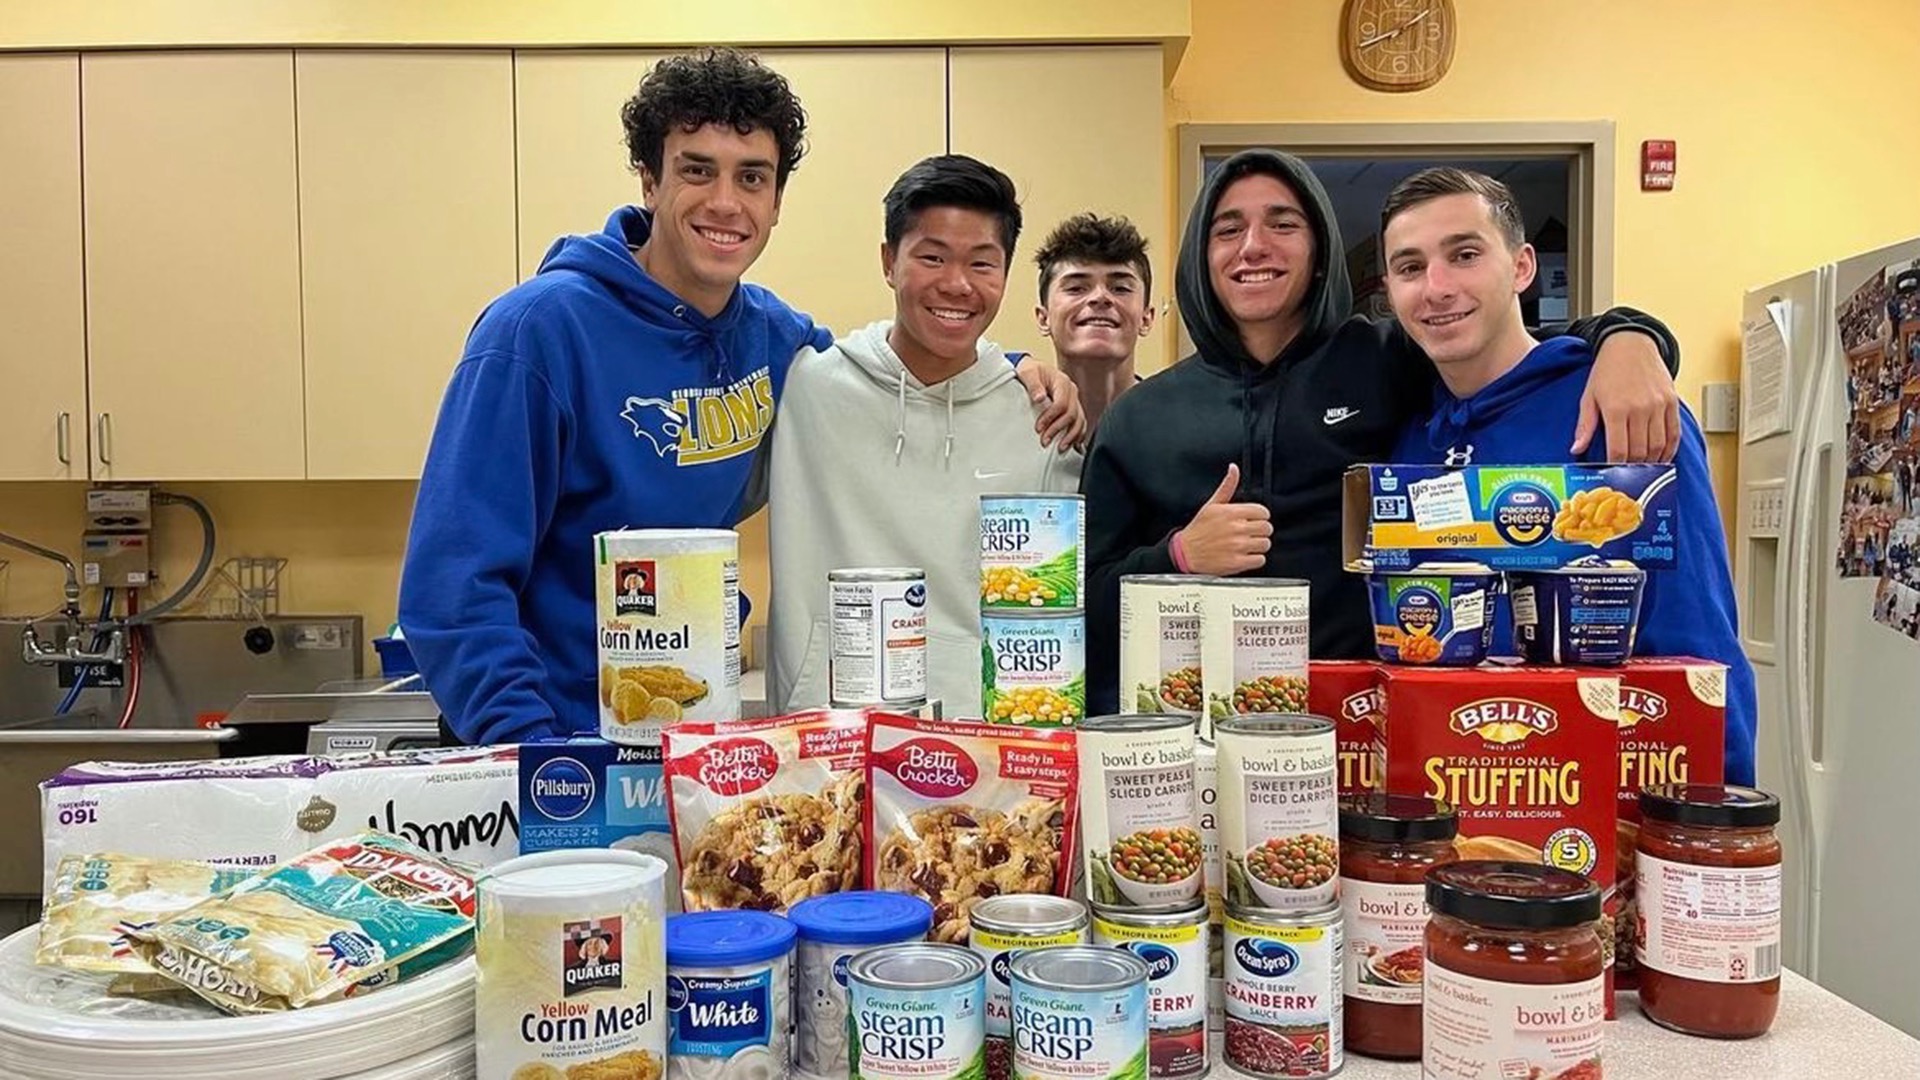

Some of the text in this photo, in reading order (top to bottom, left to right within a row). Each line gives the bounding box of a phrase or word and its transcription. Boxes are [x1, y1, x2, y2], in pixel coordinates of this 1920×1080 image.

[1360, 22, 1377, 40] 9
[1427, 22, 1441, 41] 3
[1392, 55, 1408, 73] 6
[1651, 161, 1673, 171] FIRE
[672, 376, 774, 451] LIONS
[1326, 406, 1349, 418] NIKE
[1657, 520, 1667, 533] 4
[1436, 532, 1478, 546] original
[1652, 533, 1673, 543] pack
[616, 595, 655, 608] QUAKER
[1158, 600, 1190, 614] bowl
[1232, 603, 1282, 619] bowl &
[600, 624, 689, 650] Corn Meal
[1001, 627, 1029, 636] Green
[1163, 631, 1199, 640] SLICED
[1243, 625, 1303, 636] SWEET PEAS
[996, 637, 1061, 654] steam
[1237, 637, 1276, 647] SLICED
[997, 654, 1061, 671] CRISP
[1457, 702, 1552, 730] BELL'S
[915, 722, 932, 731] New
[955, 727, 975, 735] same
[976, 728, 998, 737] great
[617, 747, 661, 762] Moist
[905, 744, 959, 771] Betty
[1006, 750, 1054, 765] Ready in
[1101, 752, 1138, 767] bowl
[1141, 753, 1155, 767] &
[1448, 756, 1560, 767] TRADITIONAL
[1006, 764, 1067, 779] 3 easy steps
[1241, 755, 1279, 773] bowl
[1283, 760, 1297, 772] &
[1620, 745, 1688, 787] FING
[699, 763, 774, 785] Crocker
[896, 761, 971, 788] Crocker
[1113, 771, 1184, 786] SWEET PEAS
[1424, 757, 1581, 806] STUFFING
[535, 778, 592, 800] Pillsbury
[1251, 778, 1326, 791] SWEET PEAS
[1110, 787, 1151, 799] SLICED
[1250, 793, 1287, 804] DICED
[57, 801, 98, 809] napkins
[59, 809, 98, 825] 160
[1473, 810, 1565, 819] EASY. DELICIOUS.
[525, 826, 599, 839] MAKES 24
[525, 838, 599, 848] CUPCAKES
[1560, 842, 1580, 860] 5
[344, 849, 476, 903] IDAHOAN
[1662, 866, 1698, 878] Nutrition
[1662, 873, 1683, 882] Facts
[1359, 897, 1418, 916] bowl &
[1685, 909, 1698, 919] 40
[1122, 930, 1146, 939] RECIPE
[1269, 929, 1279, 937] ON
[1002, 939, 1026, 947] RECIPE
[1150, 956, 1171, 974] pray
[1236, 946, 1291, 973] Ocean Spray
[566, 962, 620, 985] QUAKER
[994, 959, 1012, 978] Oce
[687, 977, 761, 991] Creamy Supreme
[1236, 978, 1296, 993] WHOLE BERRY
[866, 996, 899, 1011] Green
[1018, 991, 1048, 1008] Green
[1226, 982, 1317, 1010] CRANBERRY
[521, 989, 653, 1043] Corn Meal
[541, 1001, 590, 1018] Yellow
[687, 1000, 760, 1028] White
[1250, 1007, 1279, 1020] SAUCE
[1516, 1005, 1585, 1026] bowl &
[860, 1010, 945, 1037] steam
[1015, 1004, 1092, 1036] steam
[862, 1032, 945, 1061] CRISP
[1016, 1027, 1093, 1061] CRISP
[541, 1050, 577, 1059] ENRICHED
[578, 1048, 593, 1056] AND
[876, 1061, 948, 1073] Sweet Yellow White
